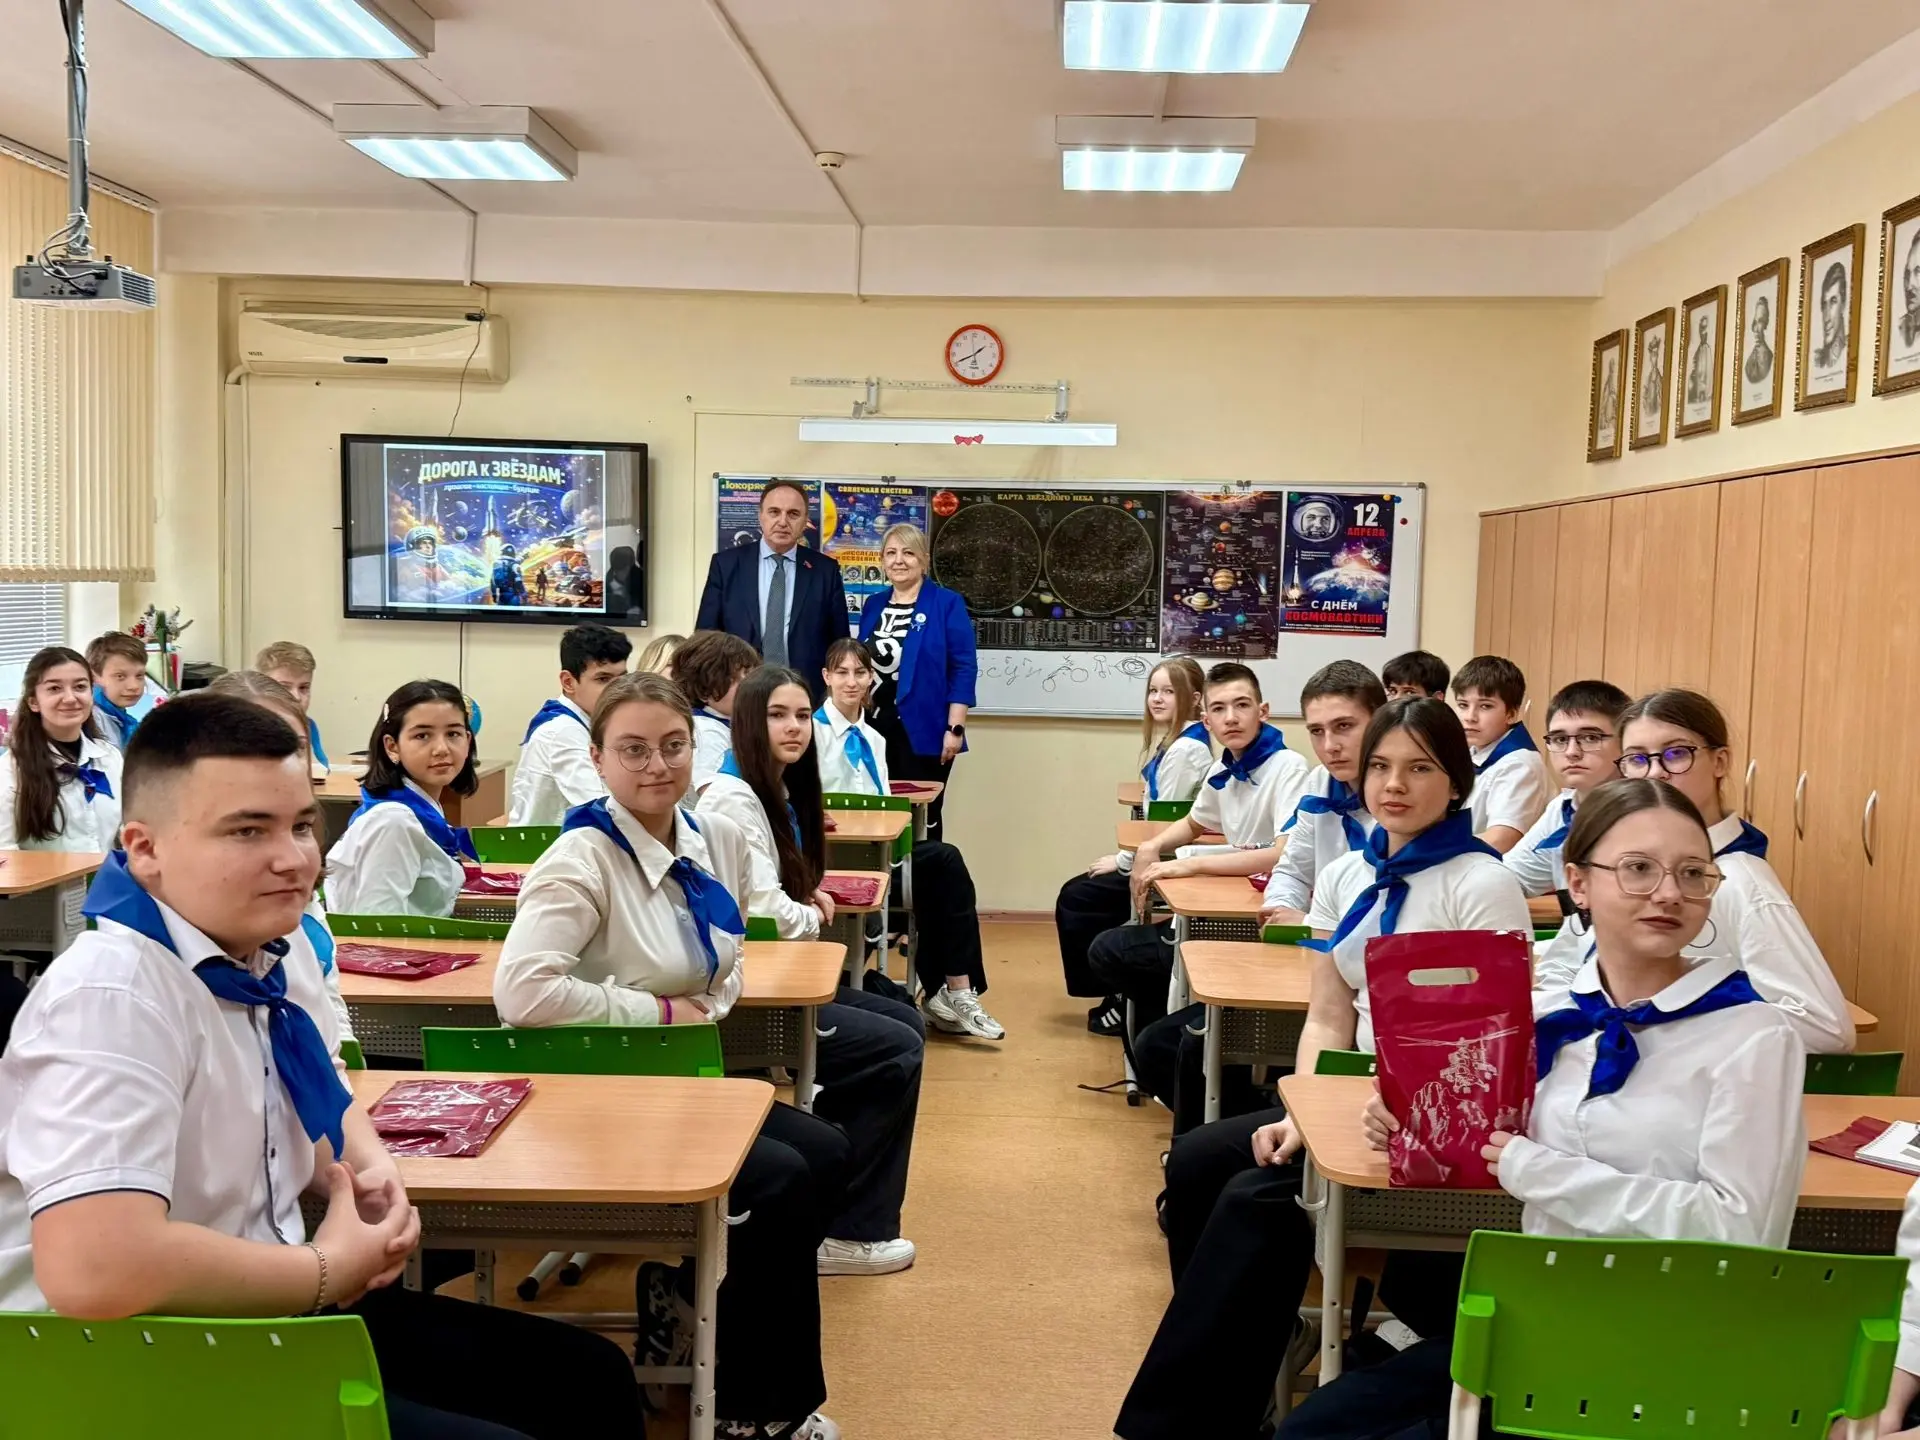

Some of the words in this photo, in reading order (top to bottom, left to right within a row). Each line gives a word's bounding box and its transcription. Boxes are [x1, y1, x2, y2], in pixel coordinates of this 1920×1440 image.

[418, 460, 478, 484] ДОРОГА
[491, 458, 566, 485] ЗВЁЗДАМ:
[880, 487, 913, 495] СИСТЕМА
[1353, 503, 1380, 527] 12
[1347, 527, 1386, 537] АПРЕЛЯ
[1311, 601, 1319, 609] С
[1322, 599, 1358, 611] ДНЁМ
[1285, 611, 1384, 624] КОСМОНАВТИКИ
